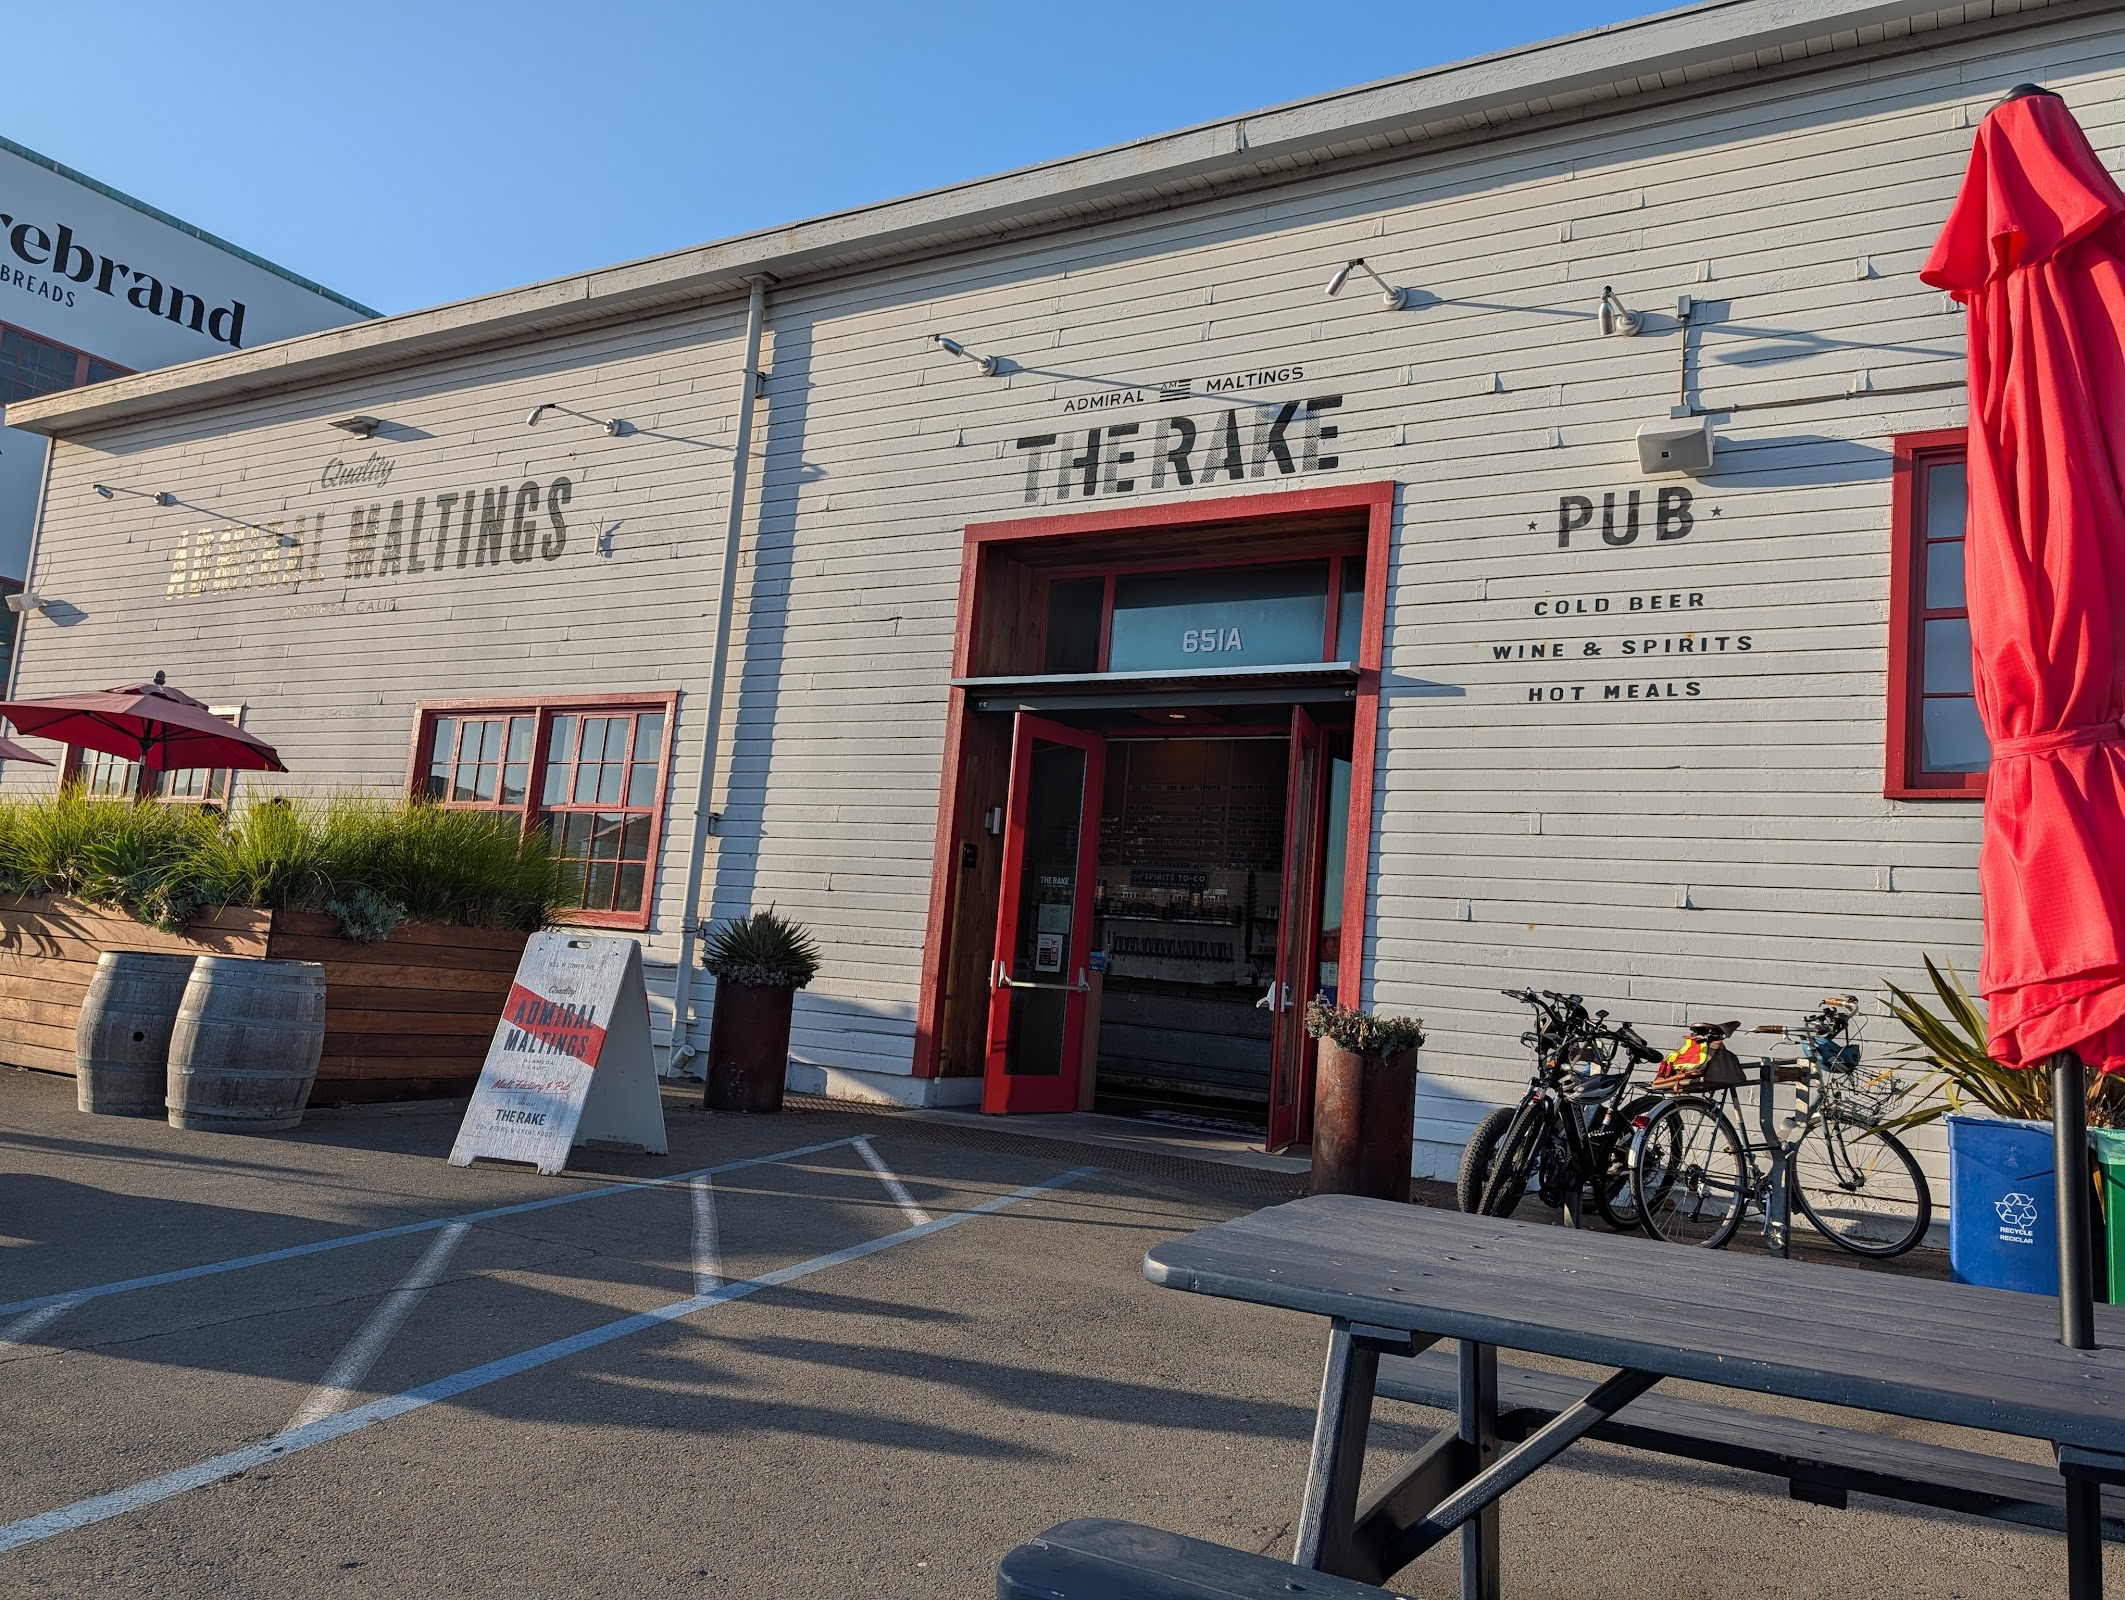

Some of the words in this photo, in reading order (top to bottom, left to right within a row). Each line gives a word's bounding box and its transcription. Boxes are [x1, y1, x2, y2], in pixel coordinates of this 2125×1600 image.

[0, 264, 76, 308] BREADS
[1064, 389, 1144, 412] ADMIRAL
[1206, 367, 1304, 393] MALTINGS
[1016, 422, 1140, 503] THE
[1151, 395, 1343, 490] RAKE
[321, 450, 396, 489] Quality
[344, 476, 572, 581] MALTINGS
[1557, 485, 1694, 548] PUB
[1534, 597, 1609, 616] COLD
[1629, 592, 1704, 611] BEER
[1182, 627, 1244, 653] 651A
[1493, 643, 1564, 660] WINE
[1583, 641, 1602, 657] &
[1622, 635, 1752, 655] SPIRITS
[1528, 685, 1585, 702] HOT
[1604, 681, 1701, 699] MEALS
[1052, 876, 1069, 885] RAKE
[1144, 873, 1174, 881] SPIRITS
[548, 985, 576, 997] Quality
[514, 999, 597, 1029] ADMIRAL
[504, 1029, 590, 1058] MALTINGS
[490, 1079, 515, 1090] Malt
[515, 1079, 545, 1093] Factory
[554, 1080, 571, 1091] Pub
[495, 1109, 516, 1122] THE
[517, 1110, 547, 1126] RAKE
[2000, 1226, 2033, 1237] RECYCLE
[2000, 1234, 2033, 1244] RECICLAR
